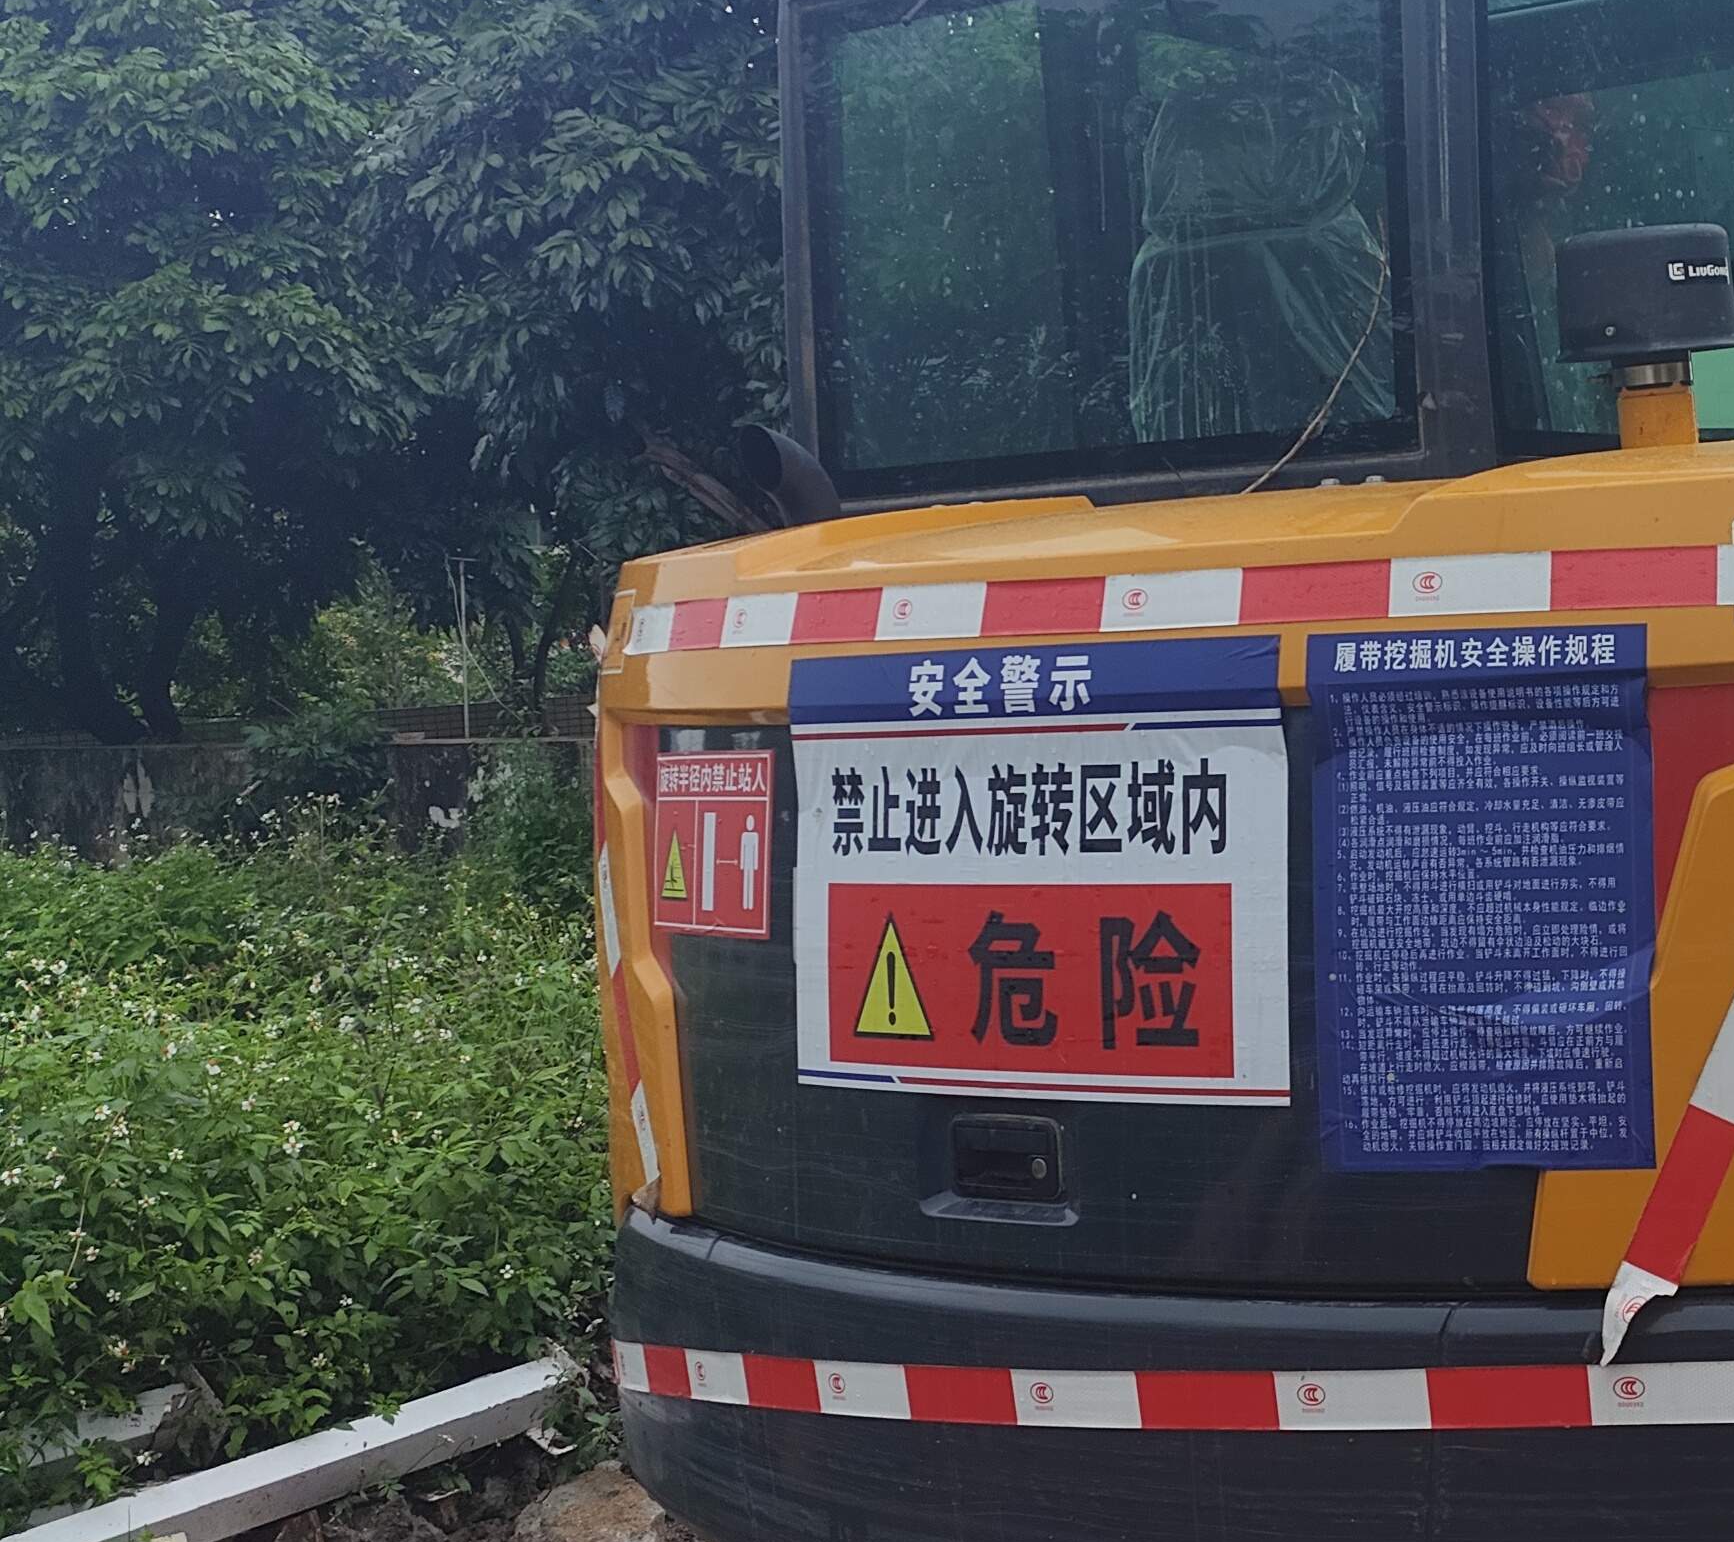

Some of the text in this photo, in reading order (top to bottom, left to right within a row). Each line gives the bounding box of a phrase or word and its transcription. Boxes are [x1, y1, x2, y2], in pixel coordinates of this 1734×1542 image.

[1333, 634, 1616, 672] 履带挖掘机安全操作规程
[908, 655, 1092, 717] 安全警示
[659, 762, 766, 793] 旋转半径内禁止站人
[832, 757, 1228, 857] 禁止进入旋转区域内
[968, 910, 1202, 1050] 危险
